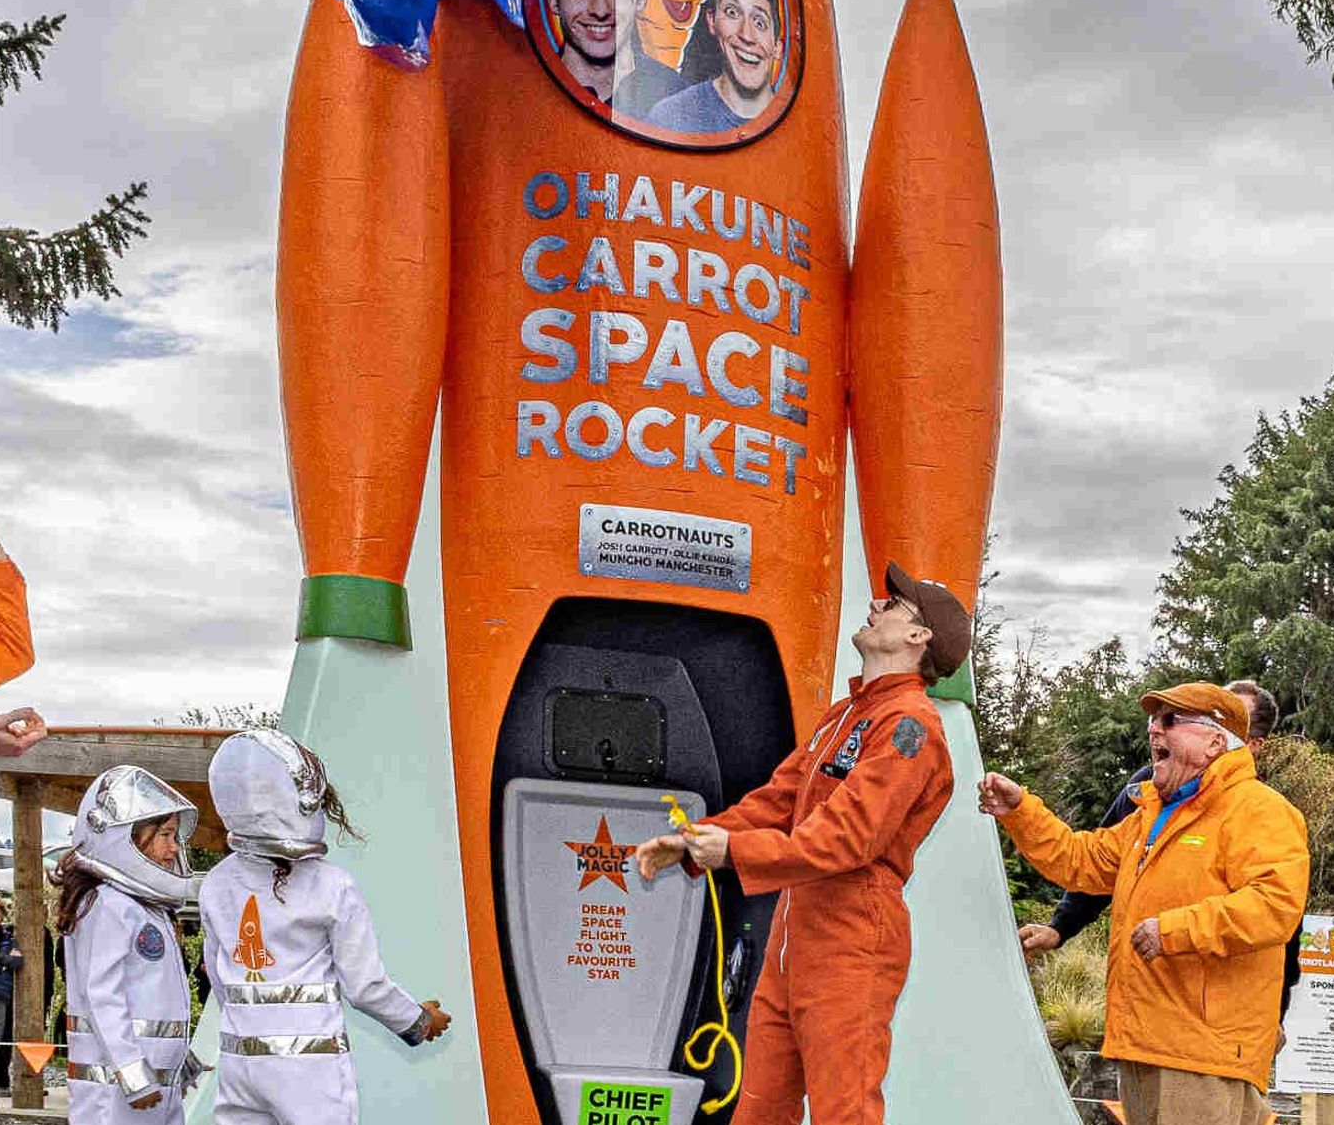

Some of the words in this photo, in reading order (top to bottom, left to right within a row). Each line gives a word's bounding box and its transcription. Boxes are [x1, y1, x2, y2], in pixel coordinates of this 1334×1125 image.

[522, 171, 811, 271] OHAKUNE
[521, 234, 810, 336] CARROT
[519, 307, 809, 425] SPACE
[516, 400, 808, 495] ROCKET
[601, 519, 735, 549] CARROTNAUTS
[599, 553, 652, 567] MUNCHO
[656, 558, 733, 577] MANCHESTER
[577, 845, 629, 859] JOLLY
[577, 858, 629, 873] MAGIC
[581, 904, 626, 916] DREAM
[581, 917, 622, 928] SPACE
[580, 930, 627, 941] FLIGHT
[576, 942, 593, 952] TO
[598, 943, 632, 954] YOUR
[567, 955, 636, 968] FAVOURITE
[587, 969, 619, 980] STAR
[589, 1088, 665, 1111] CHIEF
[588, 1112, 660, 1125] PILOT
